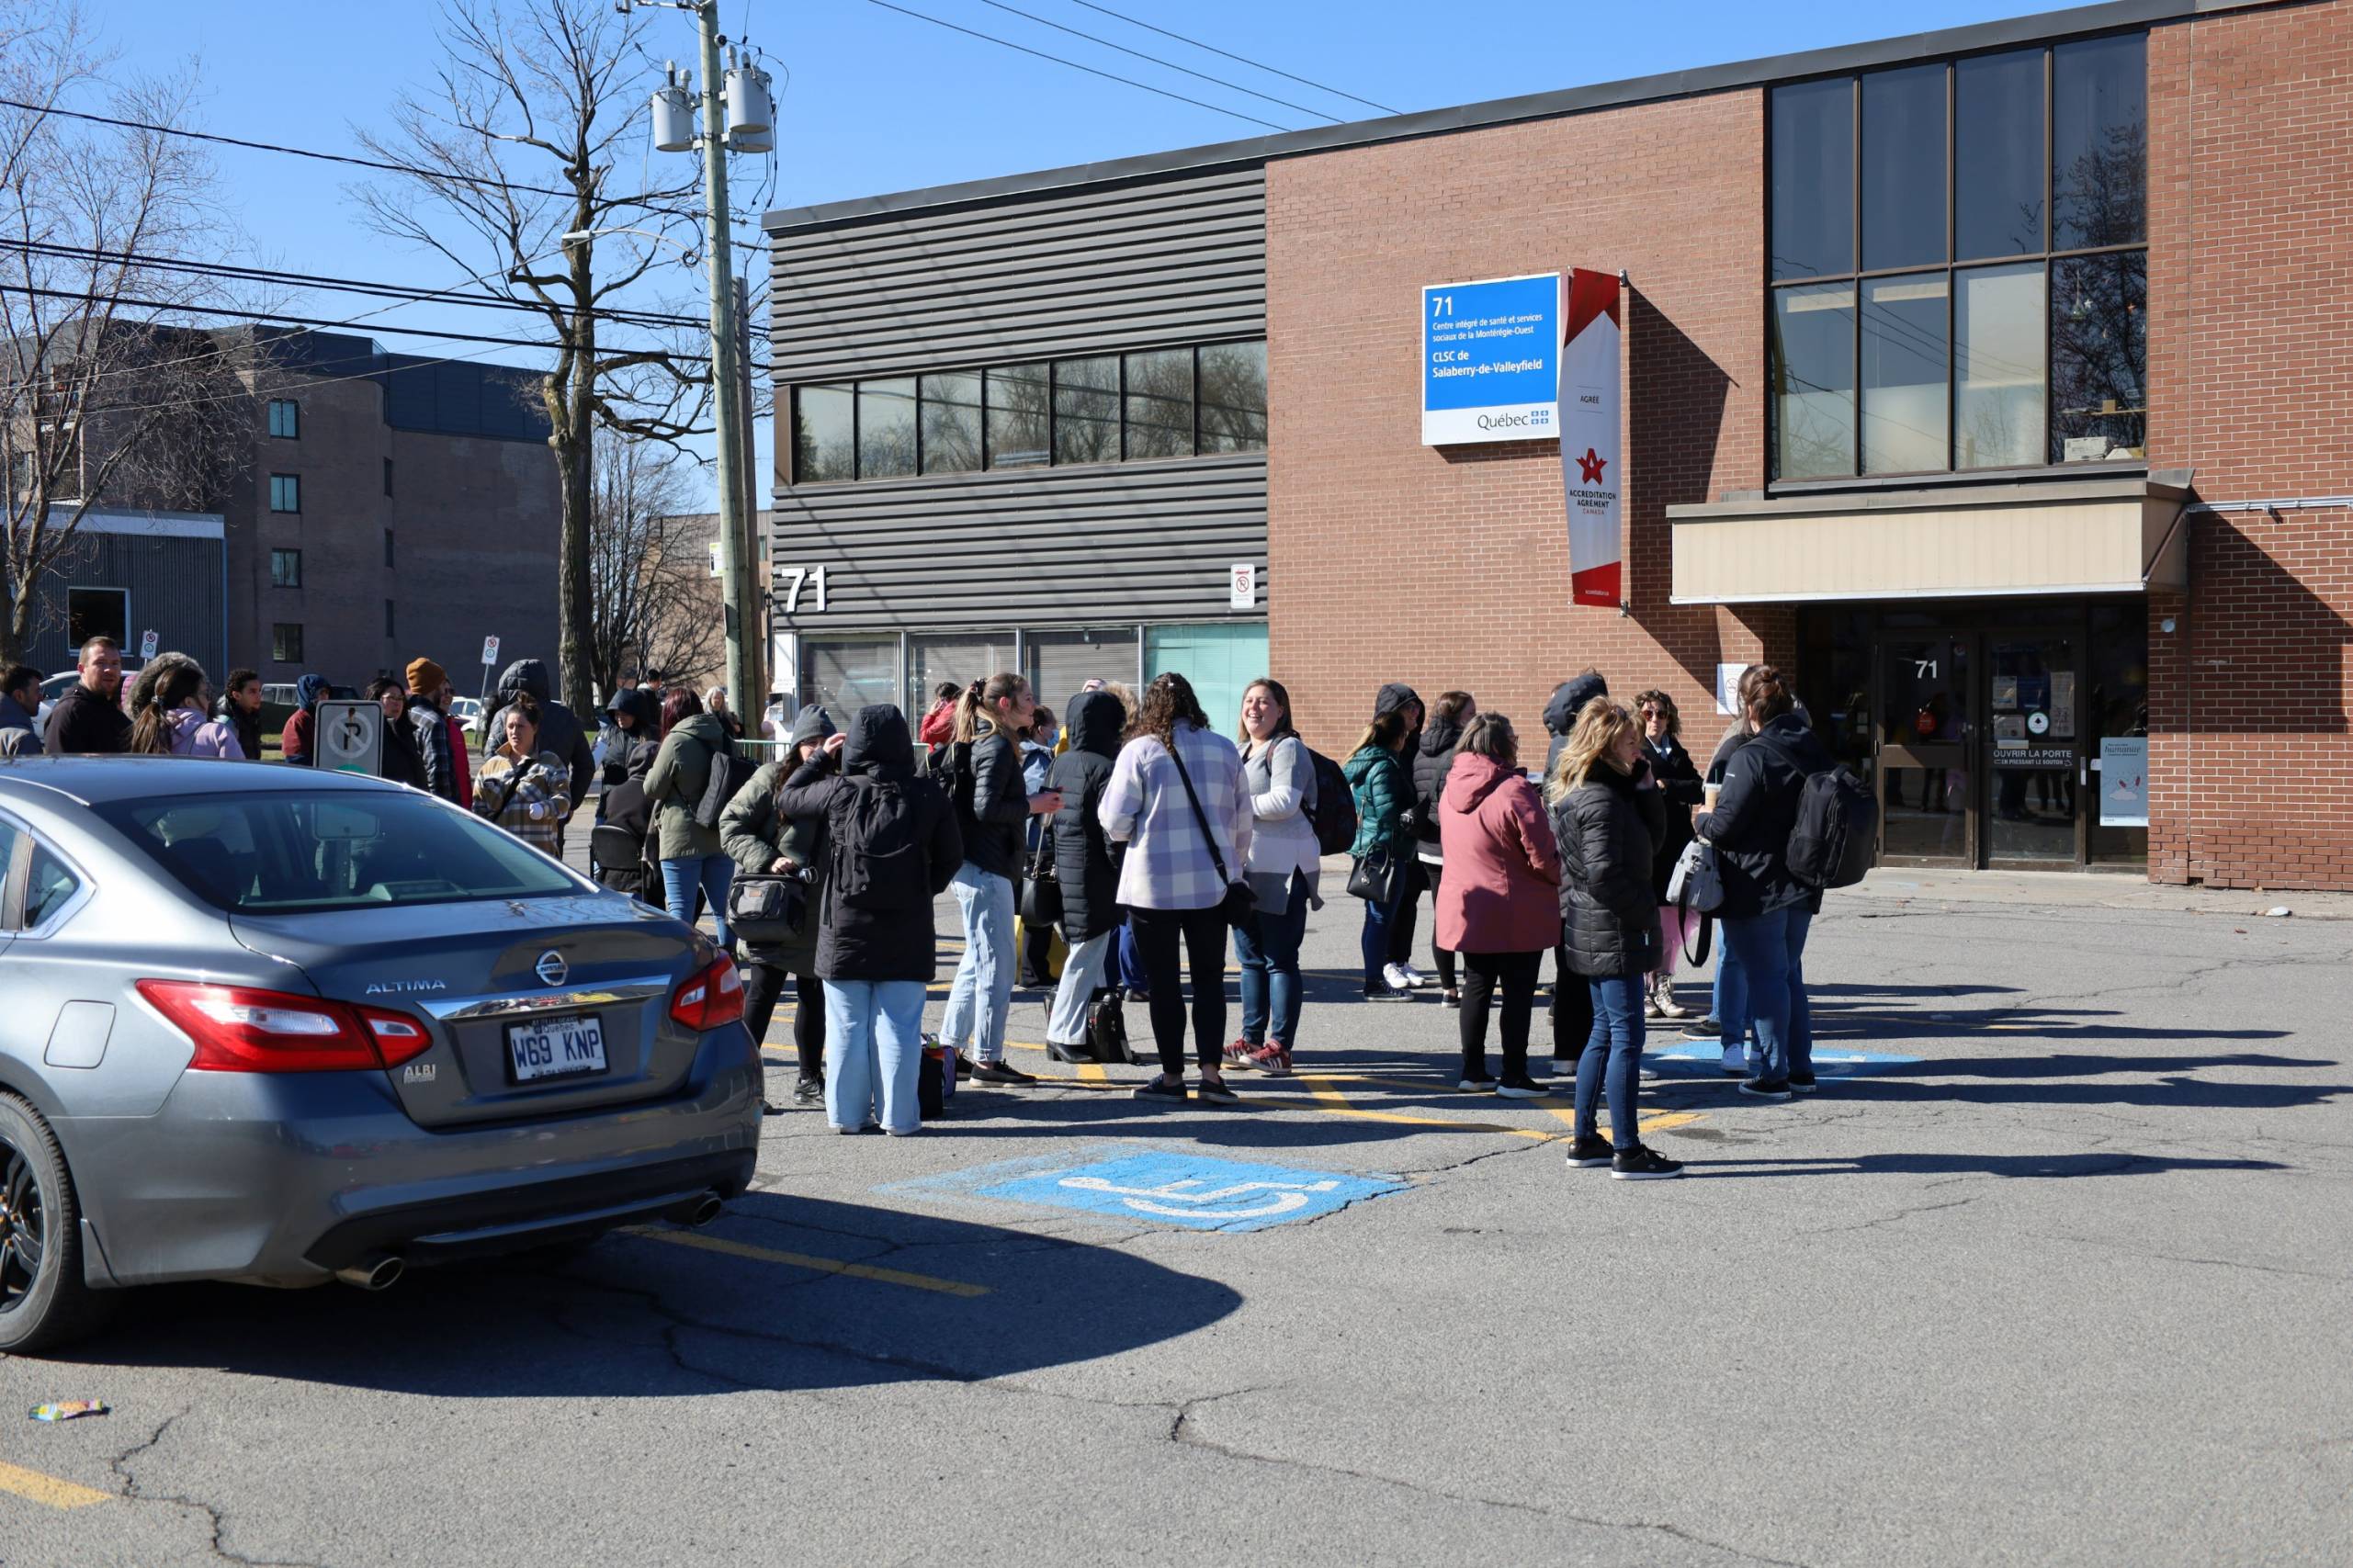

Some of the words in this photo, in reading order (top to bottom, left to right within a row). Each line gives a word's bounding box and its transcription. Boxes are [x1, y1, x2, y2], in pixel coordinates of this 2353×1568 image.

[1432, 297, 1453, 317] 71
[1433, 321, 1454, 331] Centre
[1455, 318, 1477, 330] intégré
[1489, 316, 1507, 325] santé
[1517, 314, 1542, 323] services
[1433, 333, 1456, 342] sociaux
[1458, 332, 1466, 340] de
[1468, 331, 1474, 339] la
[1476, 326, 1533, 339] Montérégie-Ouest
[1433, 351, 1454, 363] CLSC
[1458, 351, 1468, 361] de
[1433, 359, 1542, 378] Salaberry-de-Valleyfield
[1477, 413, 1529, 431] Québec
[1569, 489, 1617, 500] ACCREDITATION
[781, 565, 827, 613] 71
[1915, 660, 1938, 679] 71
[1993, 750, 2027, 758] OUVRIR
[2028, 750, 2040, 758] LA
[2042, 750, 2073, 758] PORTE
[365, 978, 447, 995] ALTIMA
[512, 1035, 553, 1068] W69
[562, 1029, 599, 1062] KNP
[403, 1063, 436, 1077] ALBI
